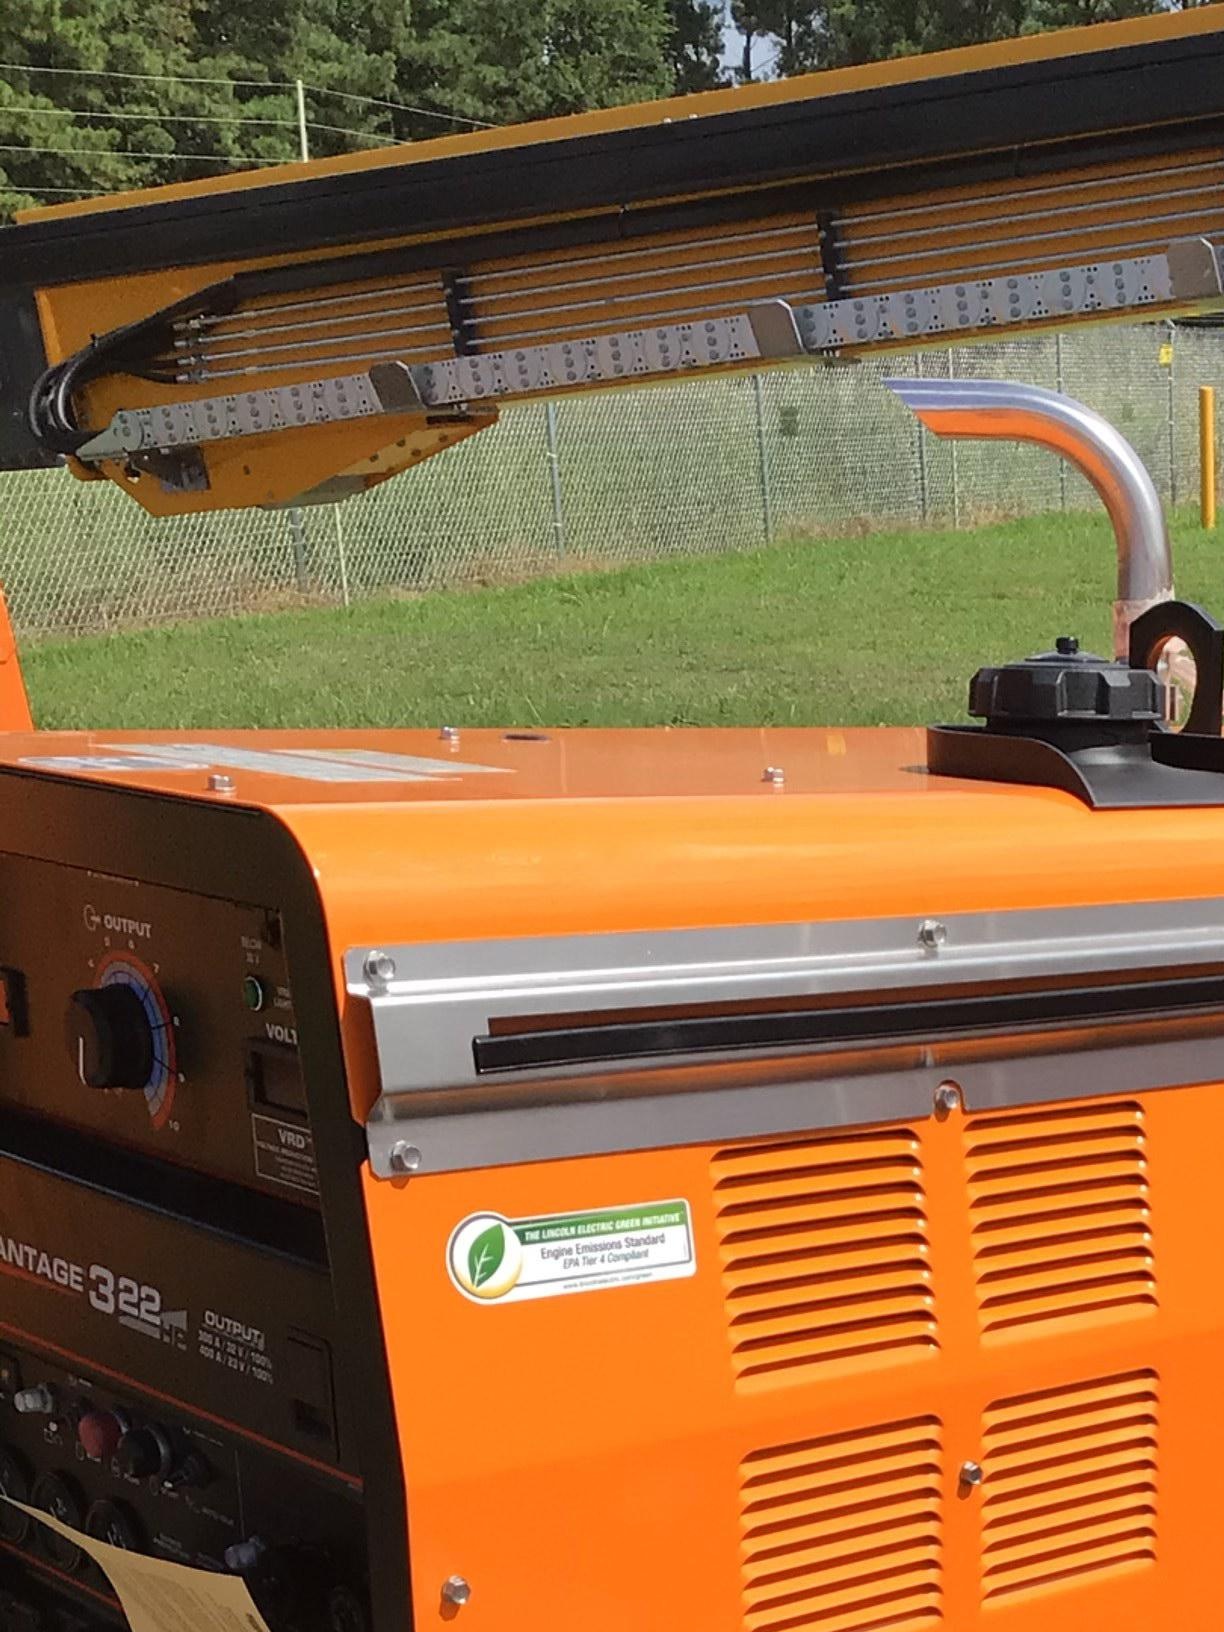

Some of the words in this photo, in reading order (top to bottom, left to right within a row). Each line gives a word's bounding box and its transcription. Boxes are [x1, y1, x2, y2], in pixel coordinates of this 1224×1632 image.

[104, 914, 152, 938] OUTPUT
[525, 1230, 541, 1241] THE
[542, 1225, 576, 1240] LINCOLN
[577, 1221, 614, 1236] ELECTRIC
[615, 1217, 641, 1230] GREEN
[642, 1213, 680, 1227] INITIATIVE
[540, 1246, 573, 1262] Engine
[575, 1241, 623, 1256] Emissions
[624, 1233, 666, 1250] Standard
[563, 1256, 580, 1270] EPA
[582, 1254, 598, 1266] Tier
[599, 1253, 606, 1264] 4
[607, 1249, 649, 1264] Compliant
[88, 1263, 162, 1326] 322
[204, 1309, 261, 1343] OUTPUT
